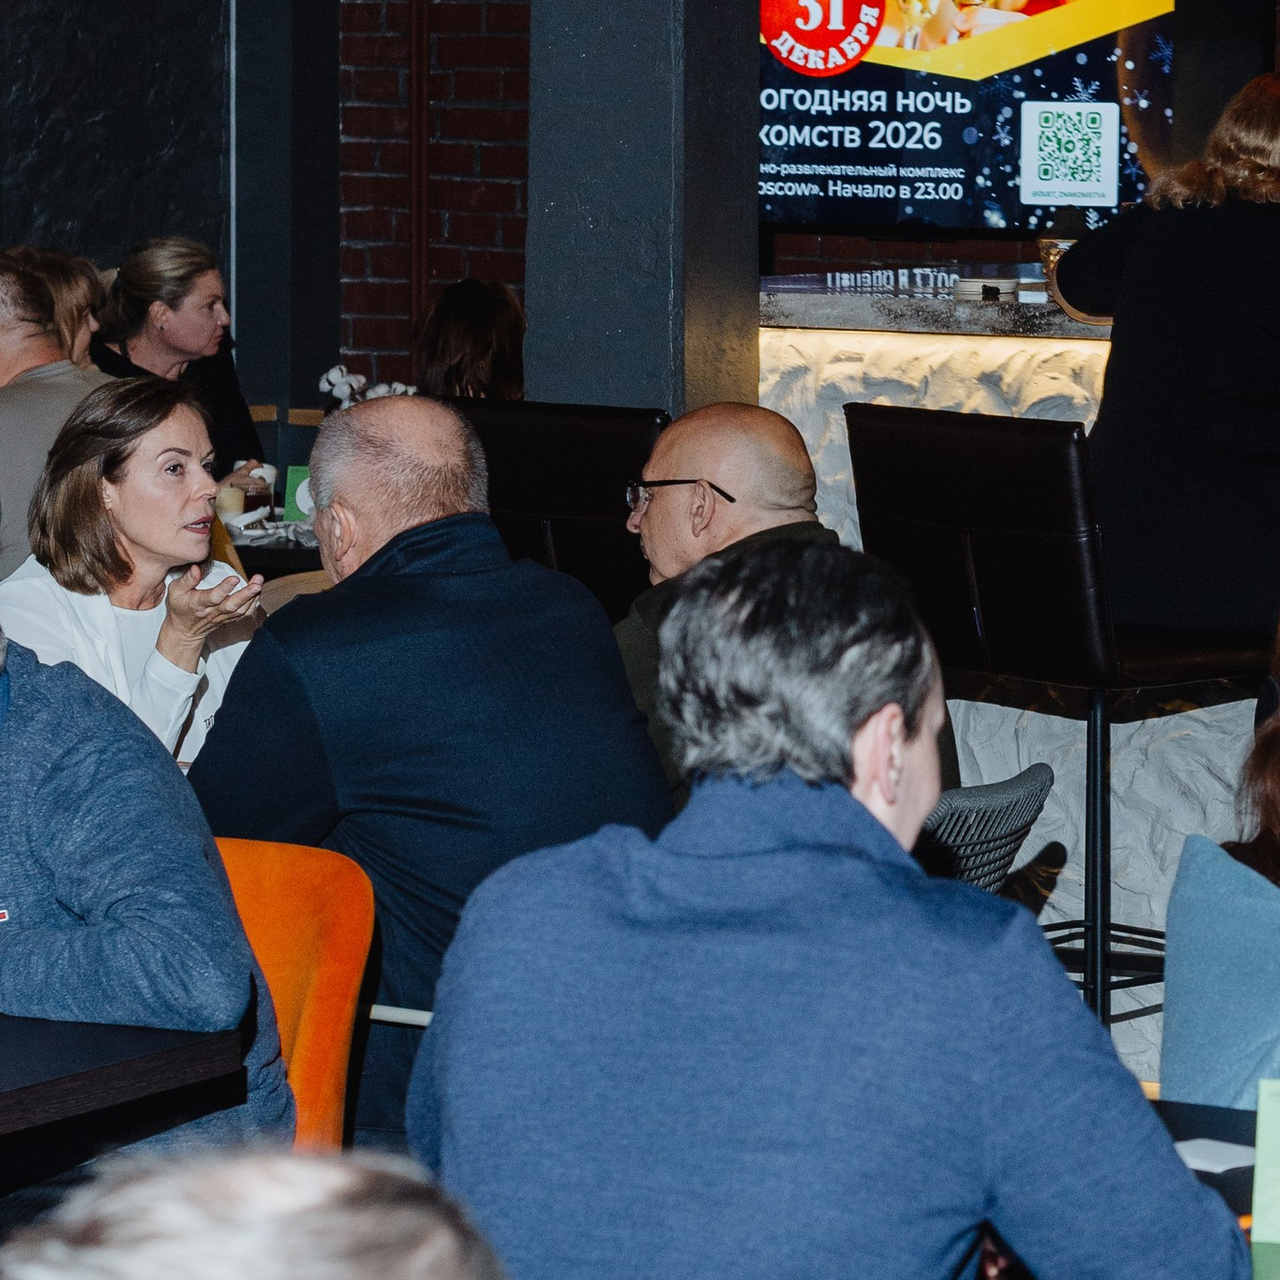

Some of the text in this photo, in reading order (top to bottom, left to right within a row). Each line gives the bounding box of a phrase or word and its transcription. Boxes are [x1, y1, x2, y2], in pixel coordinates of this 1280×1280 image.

[770, 4, 880, 70] ДЕКАБРЯ
[868, 120, 943, 150] 2026
[760, 163, 966, 179] но-развлекательный комплекс
[828, 180, 897, 199] Начало
[899, 185, 912, 199] в
[914, 182, 964, 200] 23.00
